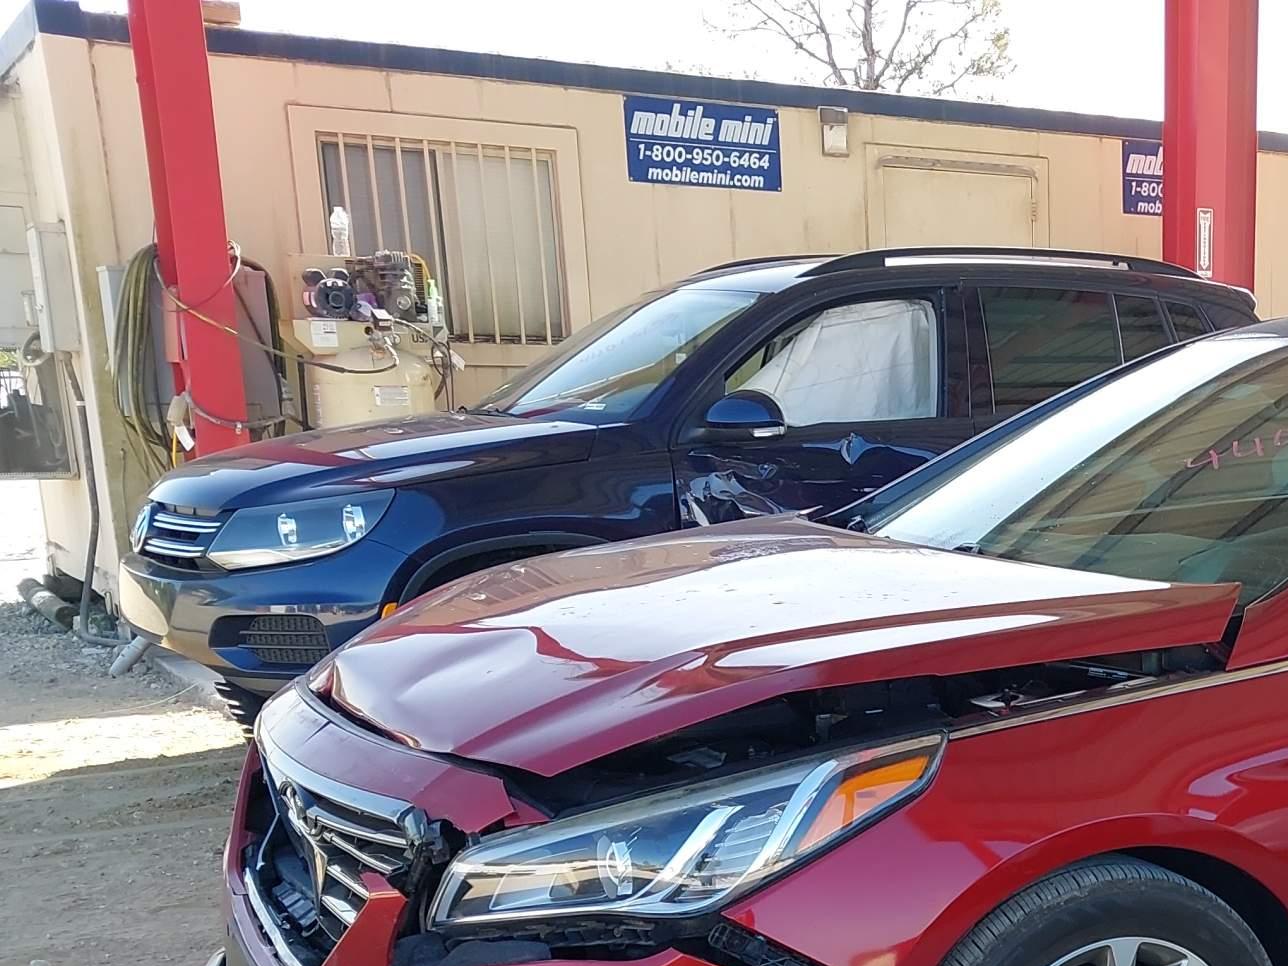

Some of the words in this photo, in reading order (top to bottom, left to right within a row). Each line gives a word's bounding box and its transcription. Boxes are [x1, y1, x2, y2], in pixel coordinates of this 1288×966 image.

[630, 103, 715, 141] mobile
[718, 115, 774, 146] mini
[638, 143, 770, 170] 1-800-950-6464
[648, 166, 764, 188] mobilemini.com
